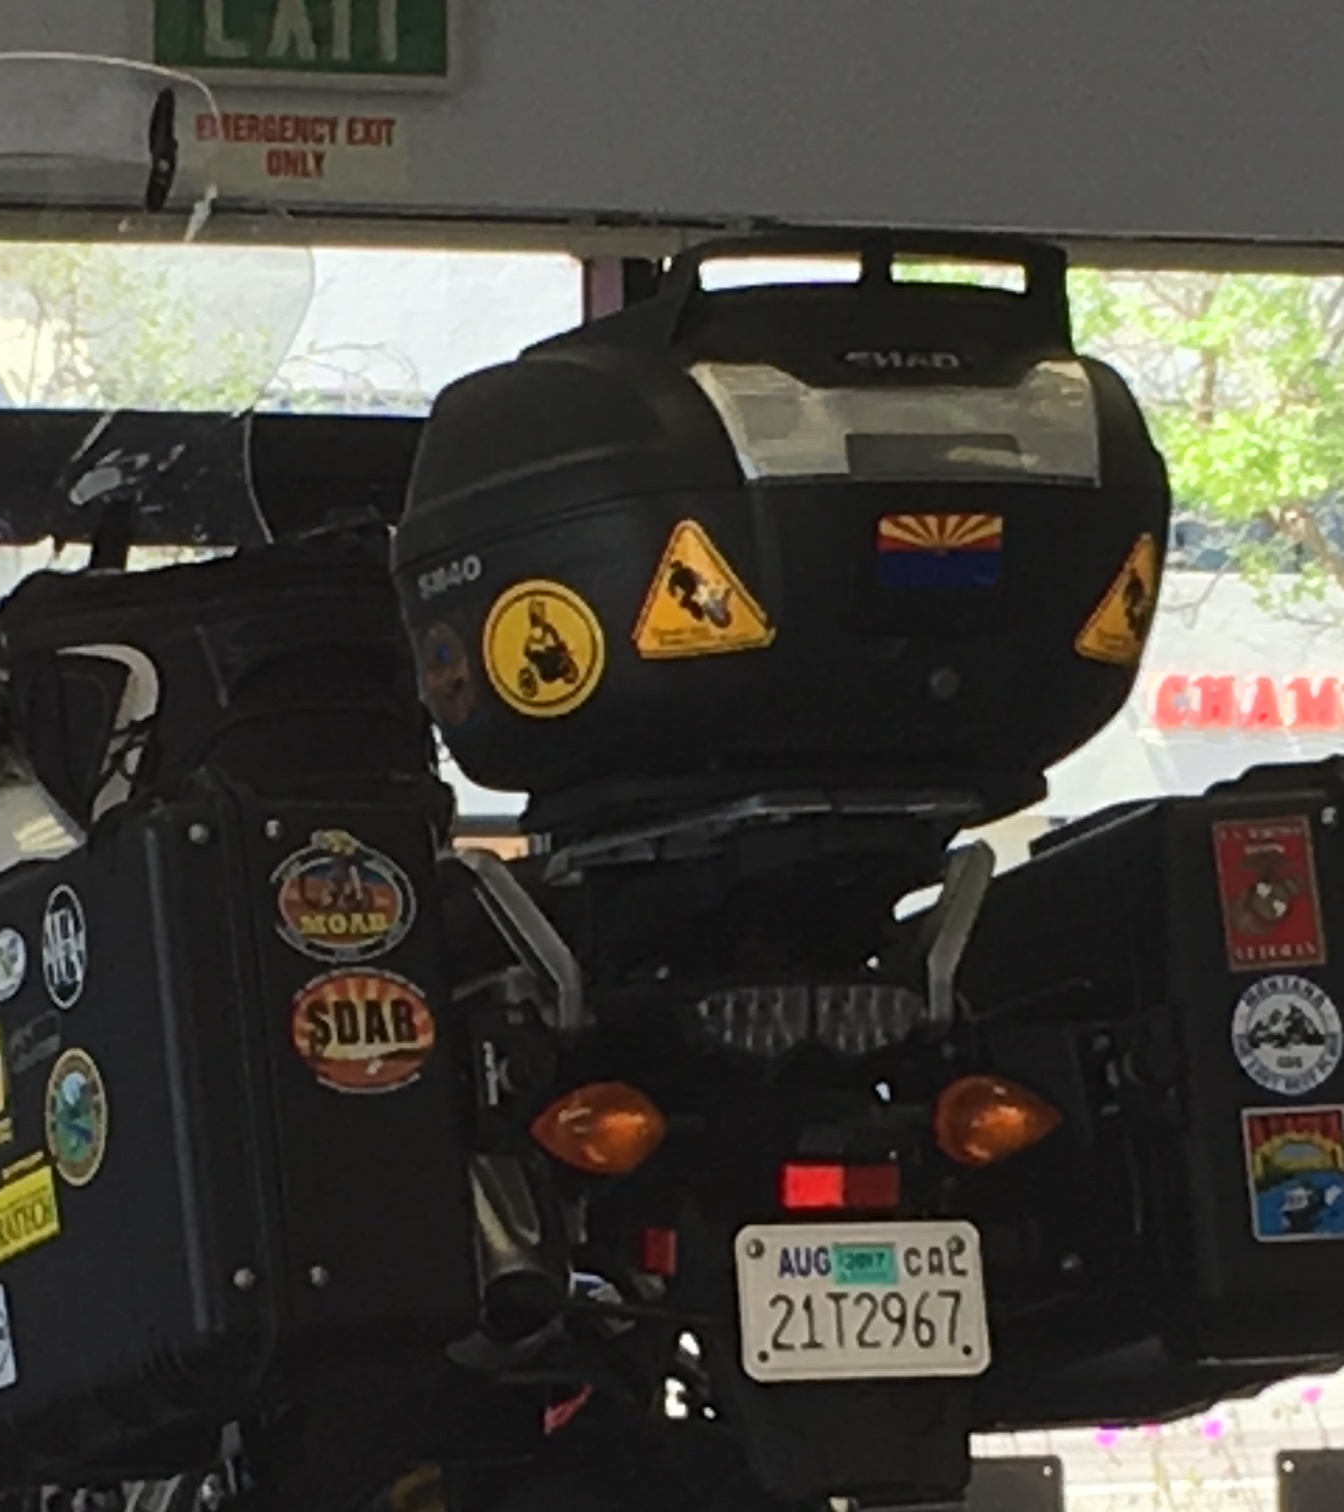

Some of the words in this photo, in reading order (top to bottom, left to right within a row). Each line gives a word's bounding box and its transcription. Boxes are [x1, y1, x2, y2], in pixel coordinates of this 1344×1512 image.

[195, 113, 338, 144] EMERGENCY
[346, 116, 397, 147] EXIT
[266, 149, 327, 179] ONLY
[299, 911, 390, 937] MOAB
[778, 1246, 831, 1278] AUG
[768, 1289, 963, 1351] 21T2967
